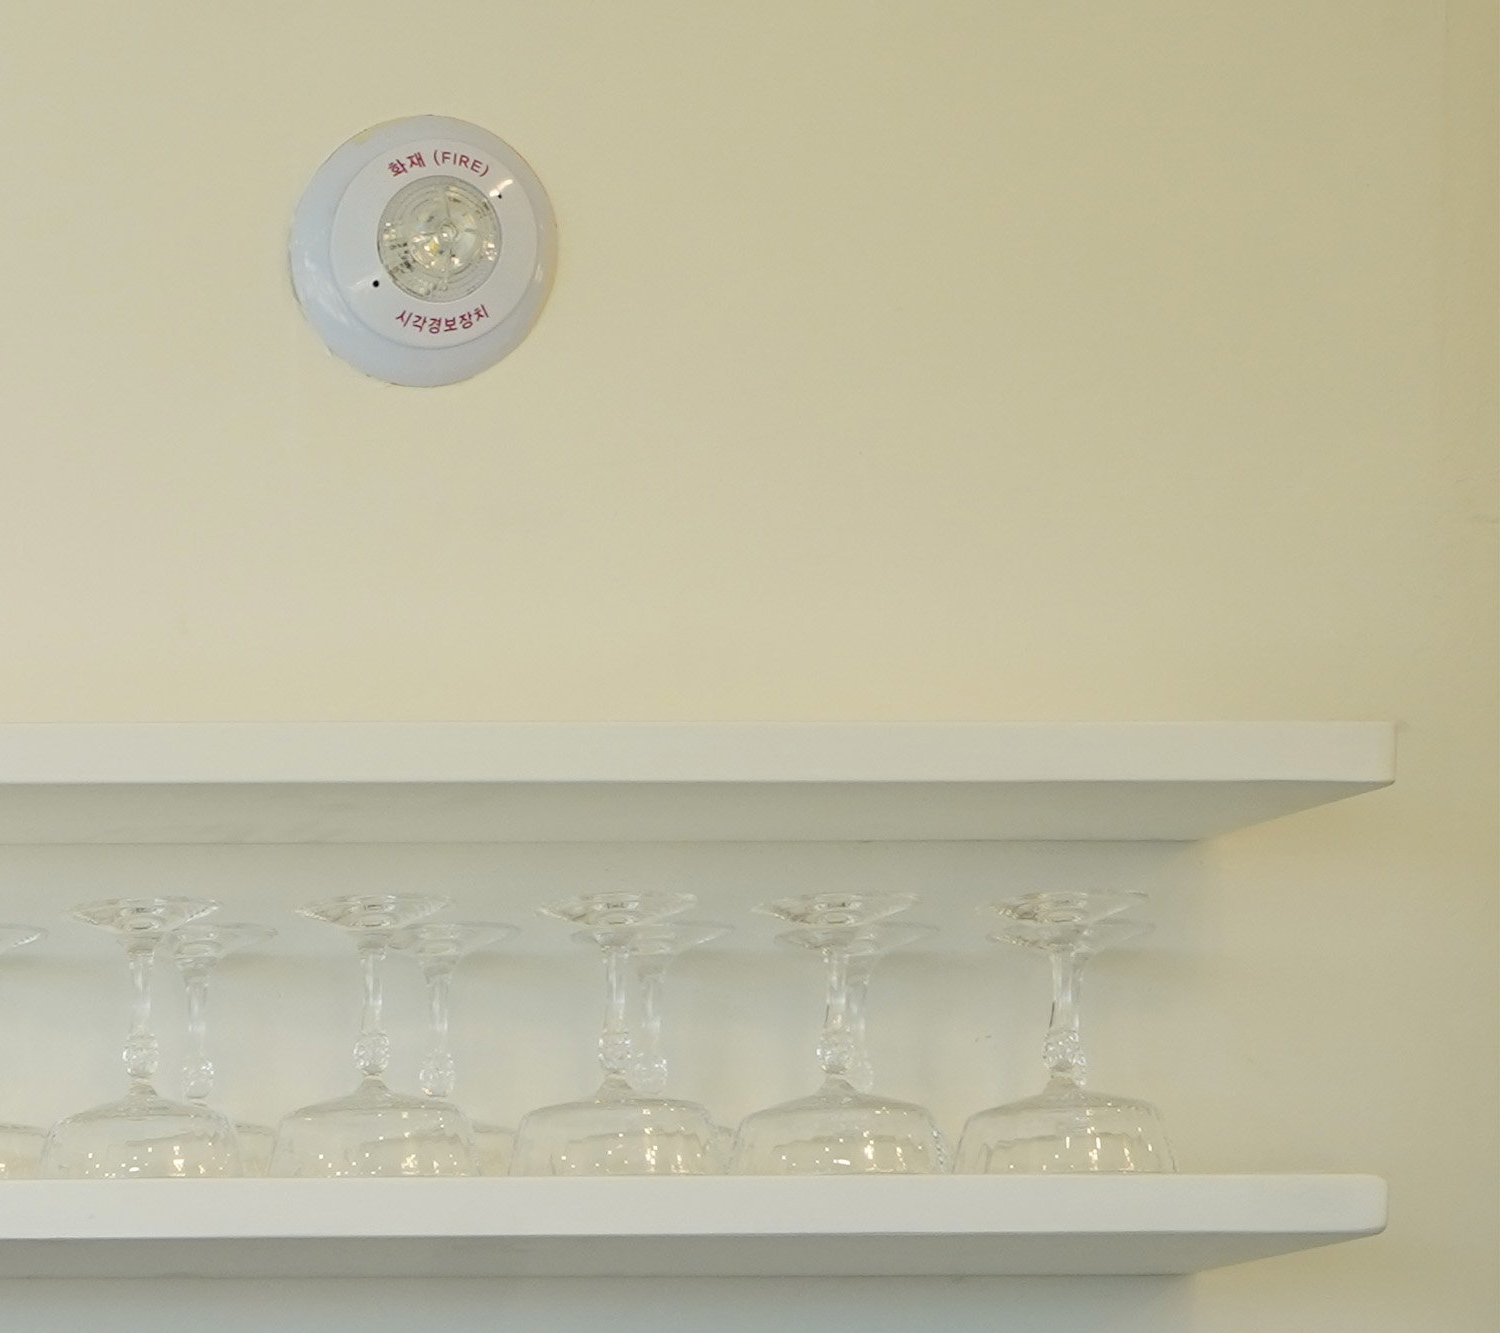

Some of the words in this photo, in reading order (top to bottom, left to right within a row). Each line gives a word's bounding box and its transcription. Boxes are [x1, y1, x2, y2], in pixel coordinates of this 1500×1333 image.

[387, 151, 426, 177] 화재
[432, 149, 490, 178] (FIRE)
[395, 303, 490, 335] 시각경보장치
